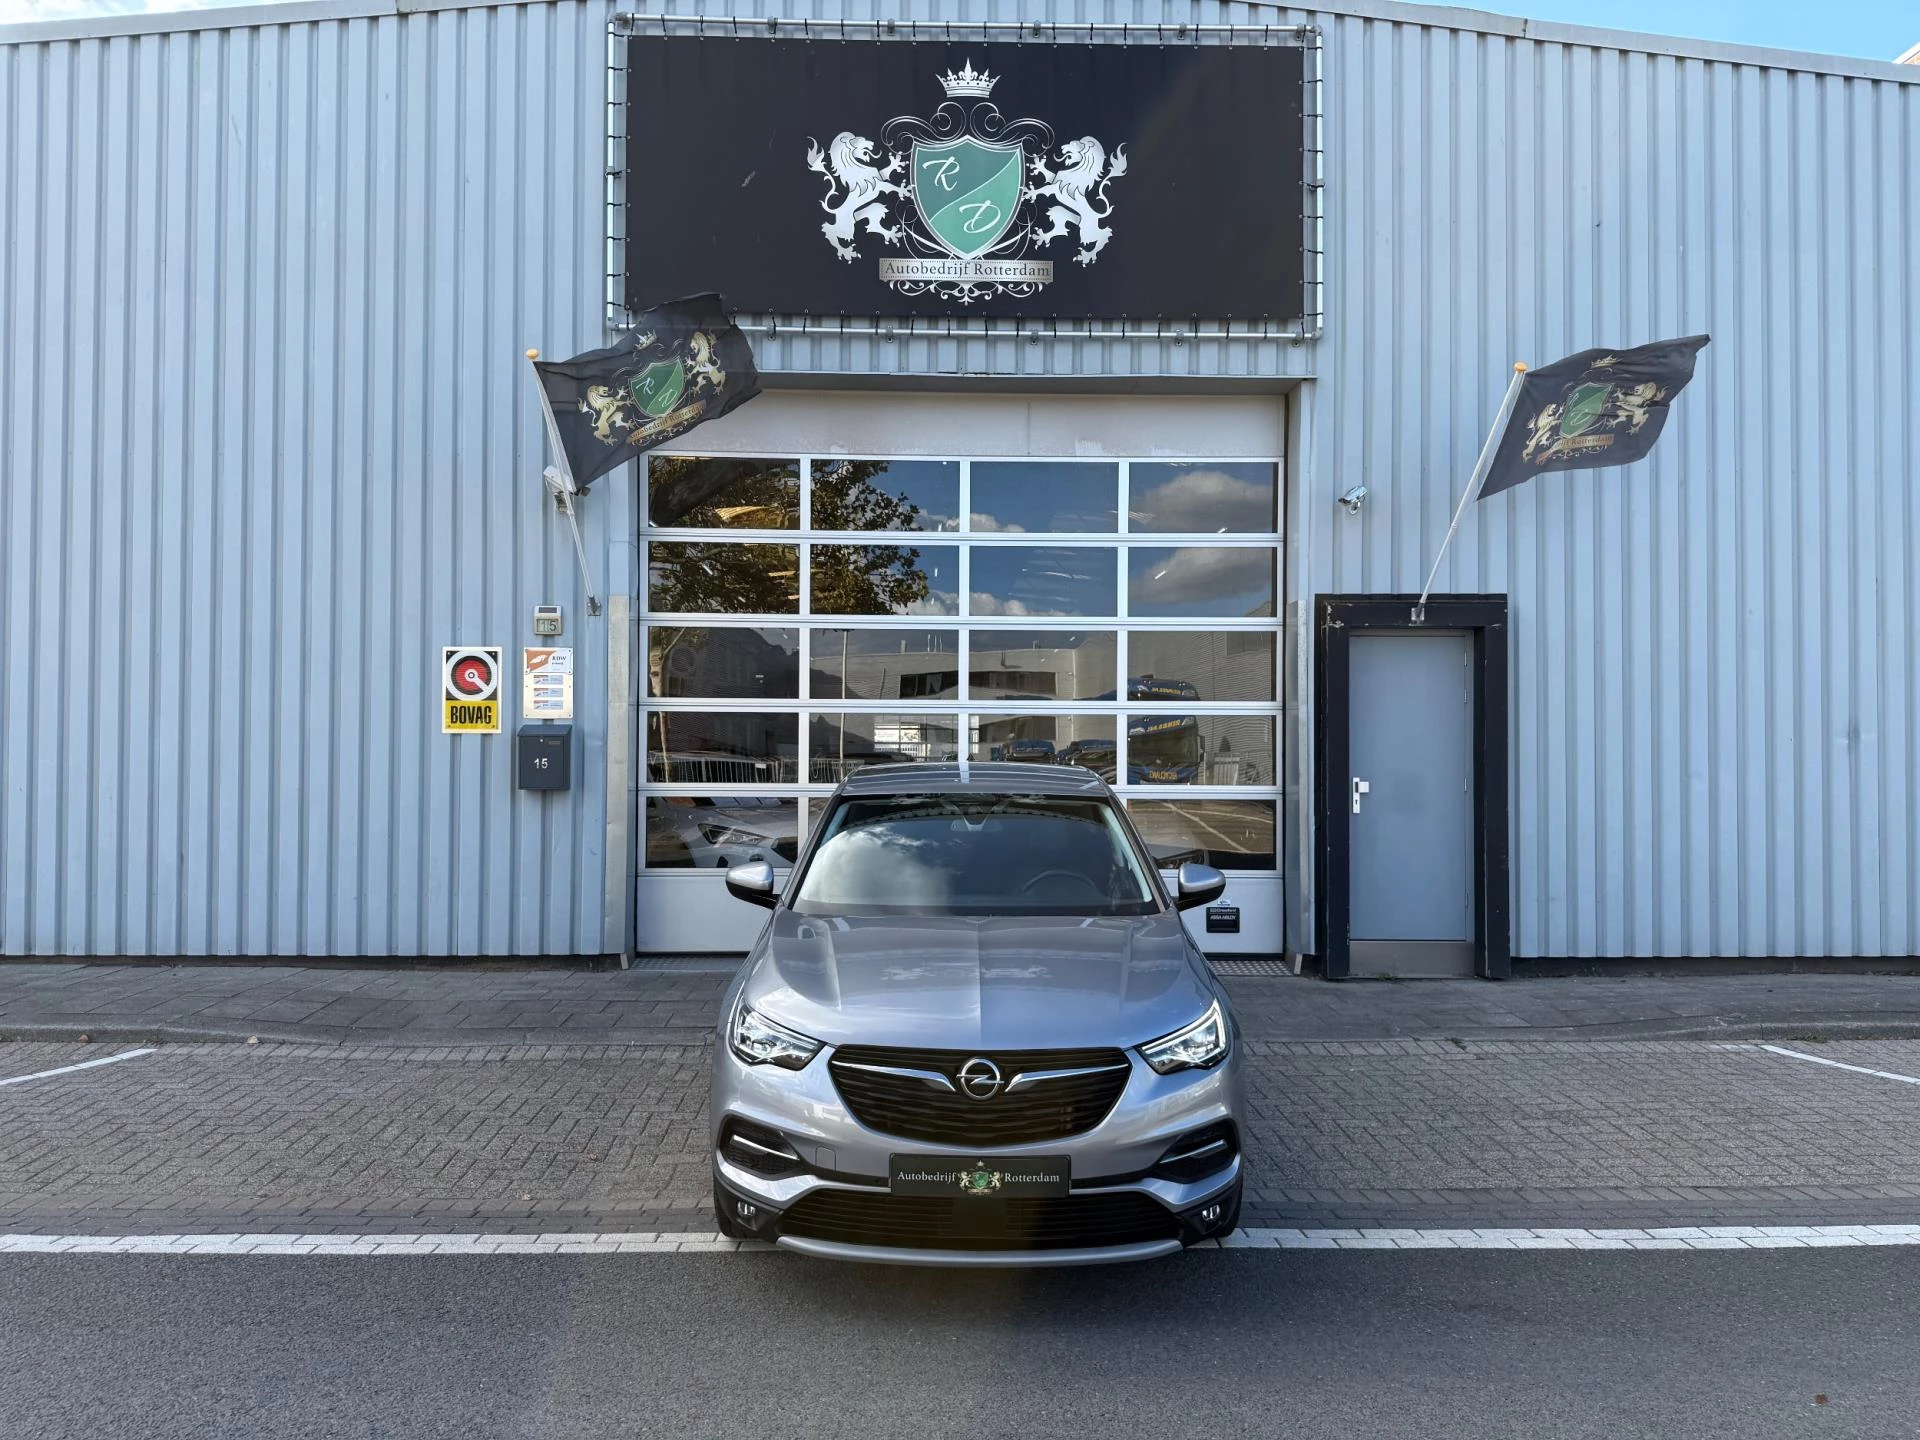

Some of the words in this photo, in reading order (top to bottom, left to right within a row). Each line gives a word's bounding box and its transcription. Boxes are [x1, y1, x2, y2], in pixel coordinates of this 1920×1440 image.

[922, 156, 960, 191] R
[958, 199, 1001, 233] D
[885, 262, 970, 278] Autobedrijf
[973, 263, 1050, 276] Rotterdam
[540, 620, 557, 631] 15
[450, 705, 492, 724] BOVAG
[534, 757, 548, 769] 15
[897, 1171, 957, 1184] Autobedrijf
[1004, 1172, 1060, 1183] Rotterdam
